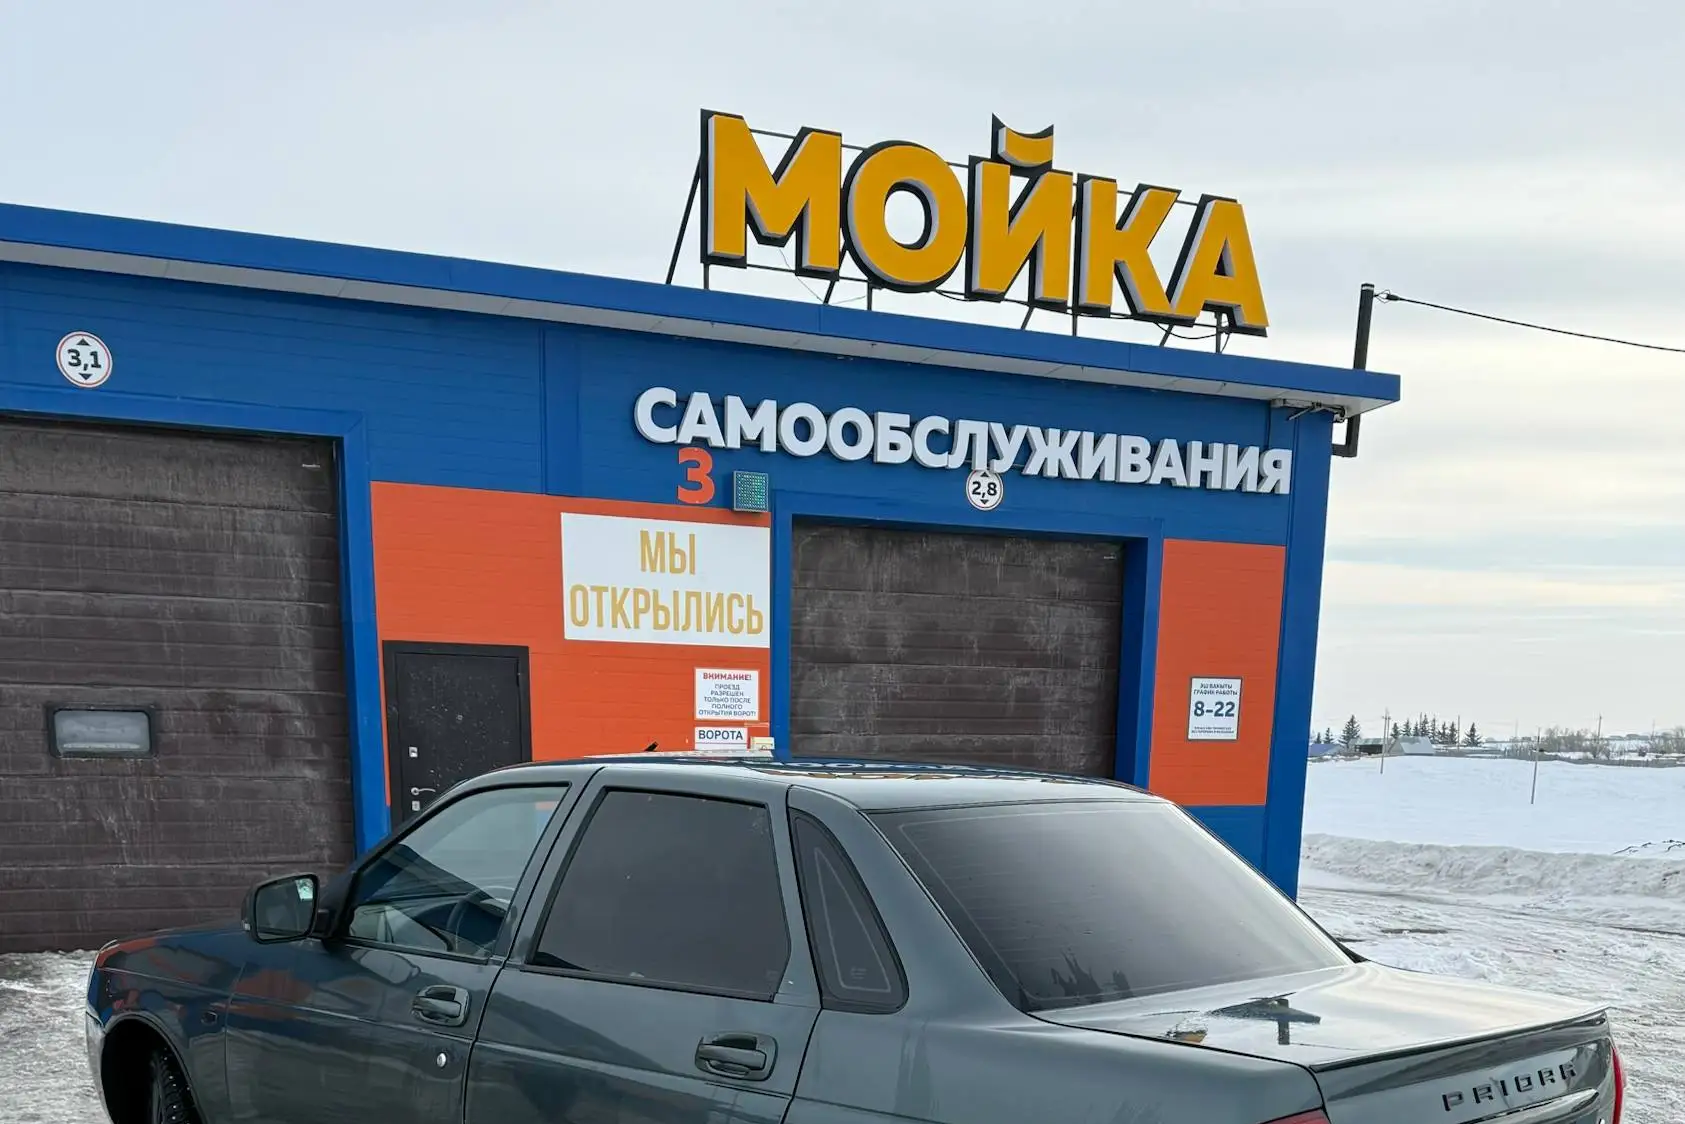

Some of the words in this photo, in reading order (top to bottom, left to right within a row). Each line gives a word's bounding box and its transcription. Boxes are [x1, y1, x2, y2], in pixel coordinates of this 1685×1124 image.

[702, 109, 1269, 336] МОЙКА
[67, 348, 102, 371] 3,1
[634, 386, 1293, 494] САМООБСЛУЖИВАНИЯ
[677, 447, 715, 504] 3
[971, 481, 998, 498] 2,8
[639, 529, 696, 575] МЫ
[569, 584, 764, 635] ОТКРЫЛИСЬ
[702, 672, 752, 681] ВНИМАНИЕ!
[1193, 700, 1236, 717] 8-22
[698, 729, 743, 741] ВОРОТА
[1441, 1061, 1577, 1112] PRIORA
